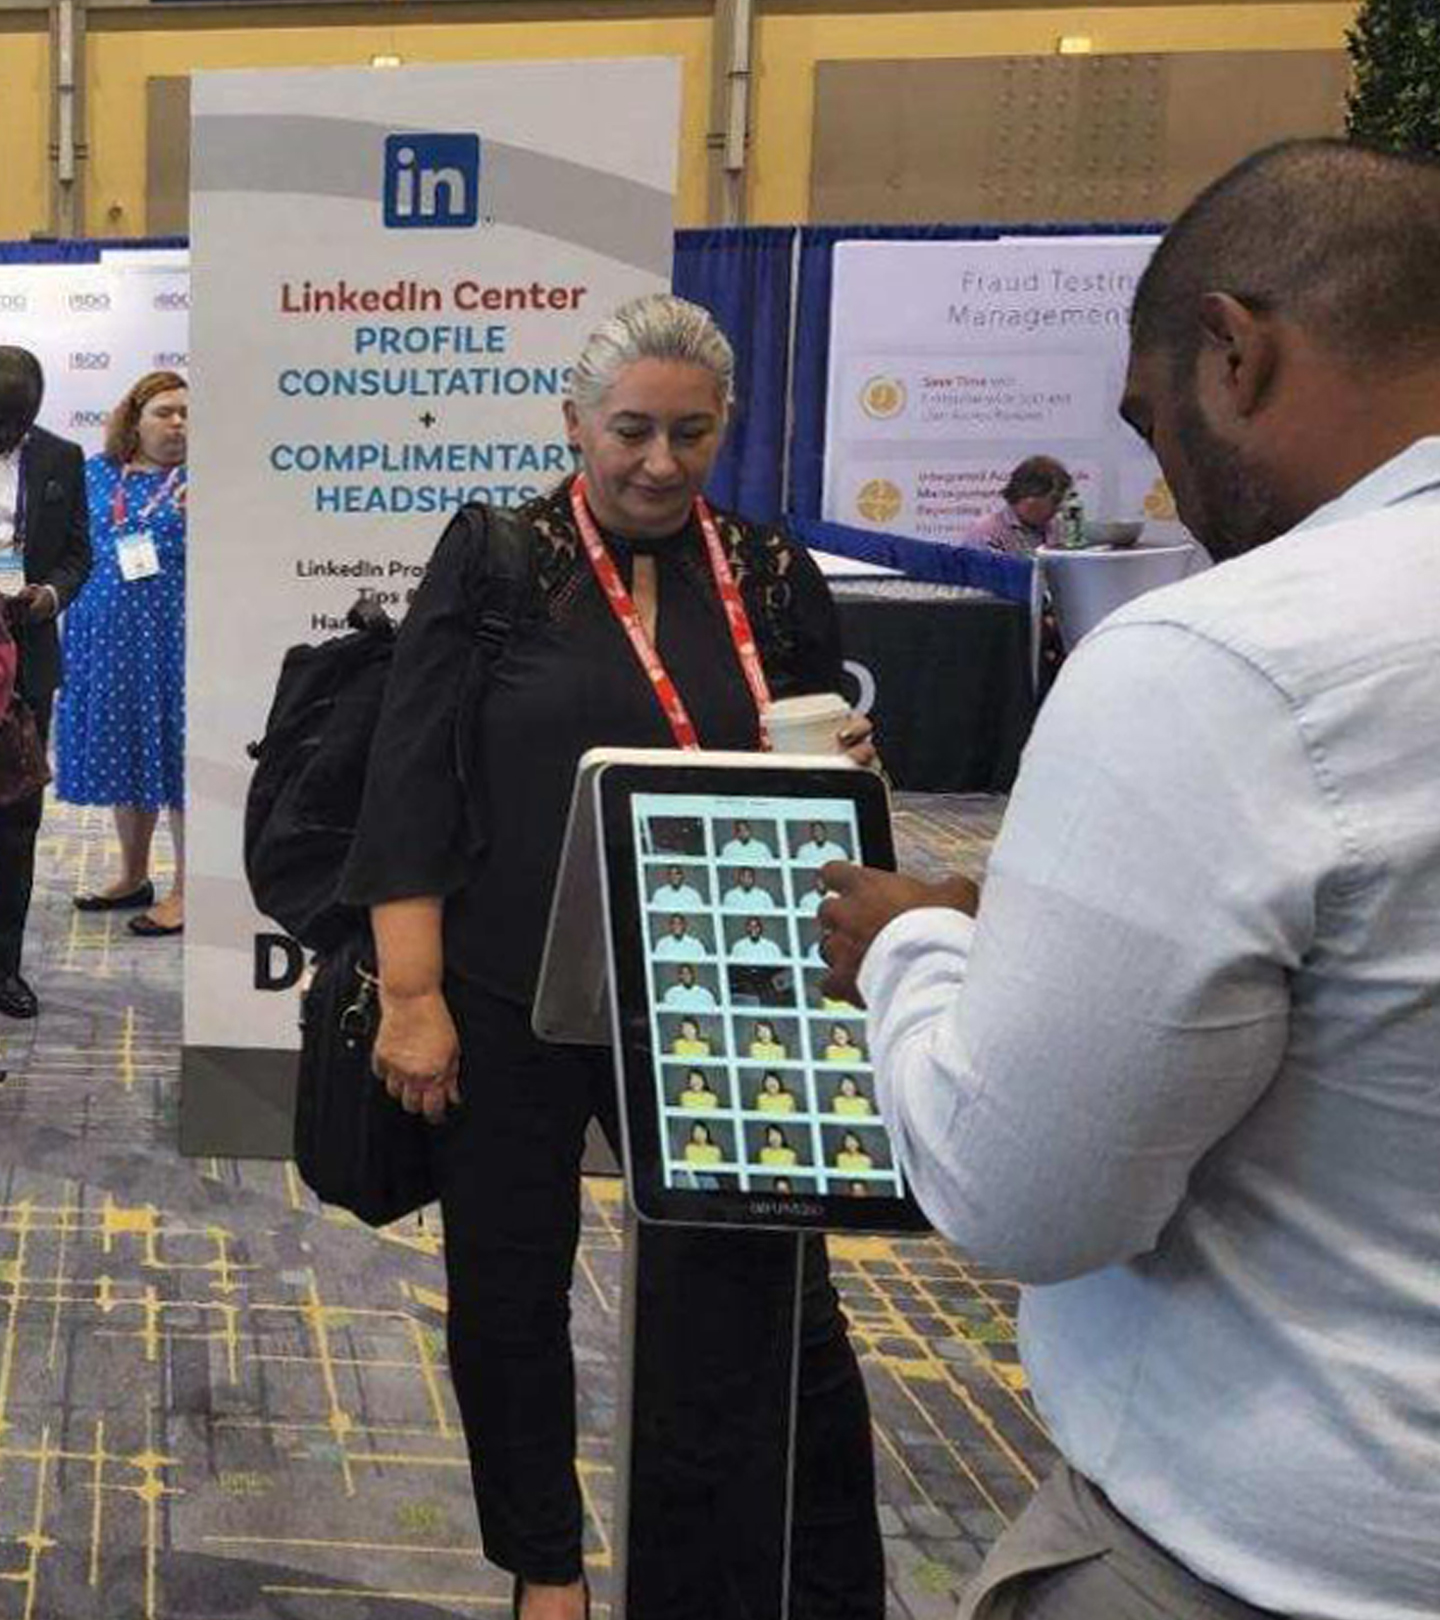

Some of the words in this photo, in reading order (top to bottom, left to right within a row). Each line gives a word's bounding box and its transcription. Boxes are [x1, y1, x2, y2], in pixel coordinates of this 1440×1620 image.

[395, 148, 465, 216] in
[962, 270, 1039, 293] Fraud
[1050, 270, 1137, 293] Testin
[281, 281, 442, 314] LinkedIn
[454, 281, 586, 311] Center
[355, 325, 506, 355] PROFILE
[419, 412, 436, 429] +
[296, 559, 384, 578] LinkedIn
[357, 588, 400, 606] Tips
